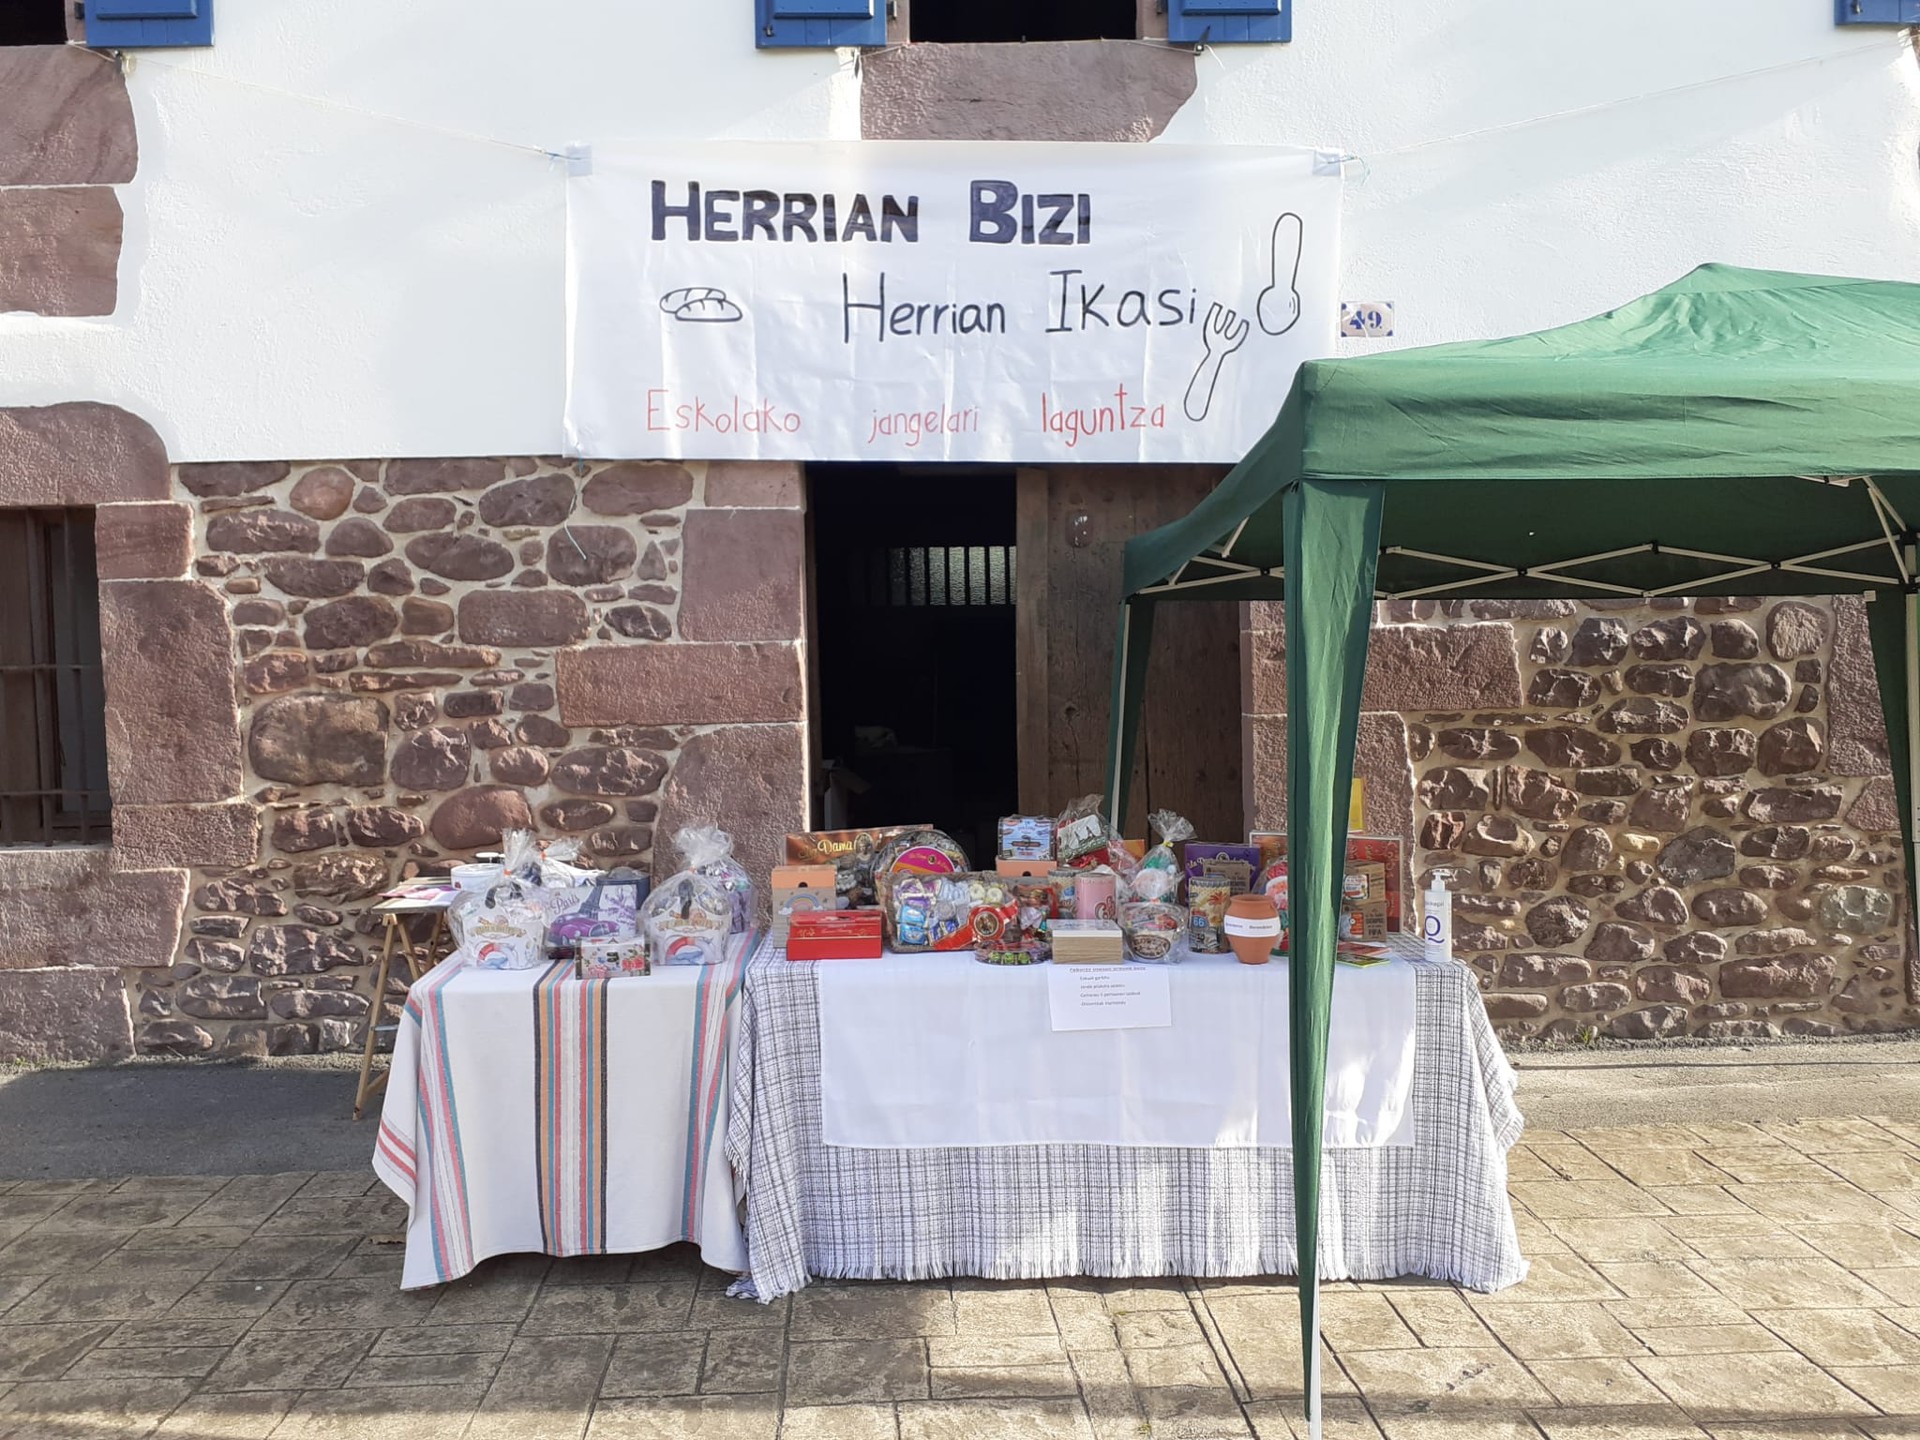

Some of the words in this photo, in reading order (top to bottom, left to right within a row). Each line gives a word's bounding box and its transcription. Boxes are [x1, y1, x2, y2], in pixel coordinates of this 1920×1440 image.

[652, 180, 919, 243] HERRIAN
[970, 180, 1091, 245] BIZI
[842, 272, 1006, 344] Herrian
[646, 388, 801, 435] Eskolako
[867, 403, 980, 446] jangelari
[1041, 383, 1166, 448] laguntza
[817, 839, 853, 855] Dama
[550, 895, 580, 914] Paris
[1193, 917, 1206, 927] 66
